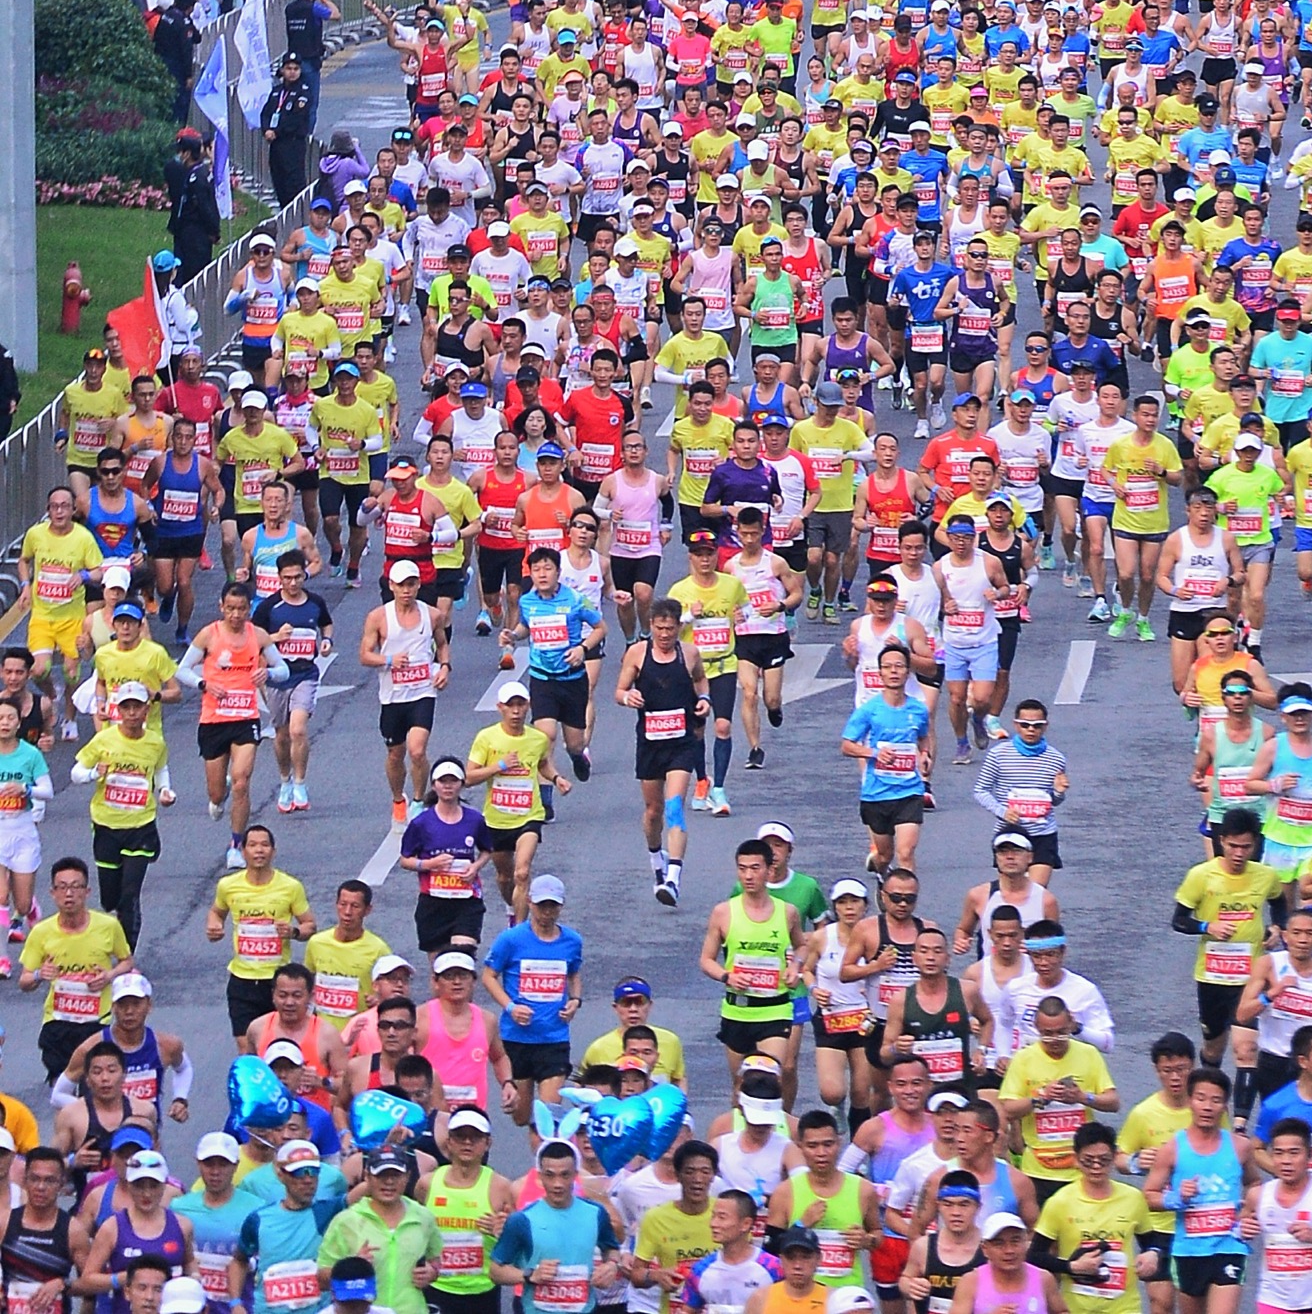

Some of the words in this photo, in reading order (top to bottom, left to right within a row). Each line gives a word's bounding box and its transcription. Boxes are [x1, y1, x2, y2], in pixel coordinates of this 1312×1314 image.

[534, 629, 564, 641] A1204
[697, 629, 728, 643] A2341
[281, 641, 312, 653] A0178
[396, 668, 427, 683] B2643
[220, 696, 252, 708] A0587
[650, 716, 682, 729] A0684
[109, 789, 143, 803] B2217
[496, 791, 529, 805] B1149
[435, 874, 463, 888] A302
[241, 940, 277, 953] A2452
[317, 991, 353, 1008] A2379
[928, 1058, 957, 1071] 1756
[250, 1068, 290, 1115] 3:30
[356, 1091, 408, 1121] 3:30
[444, 1252, 478, 1266] 2635
[820, 1250, 851, 1265] 1264
[270, 1280, 315, 1299] A2115
